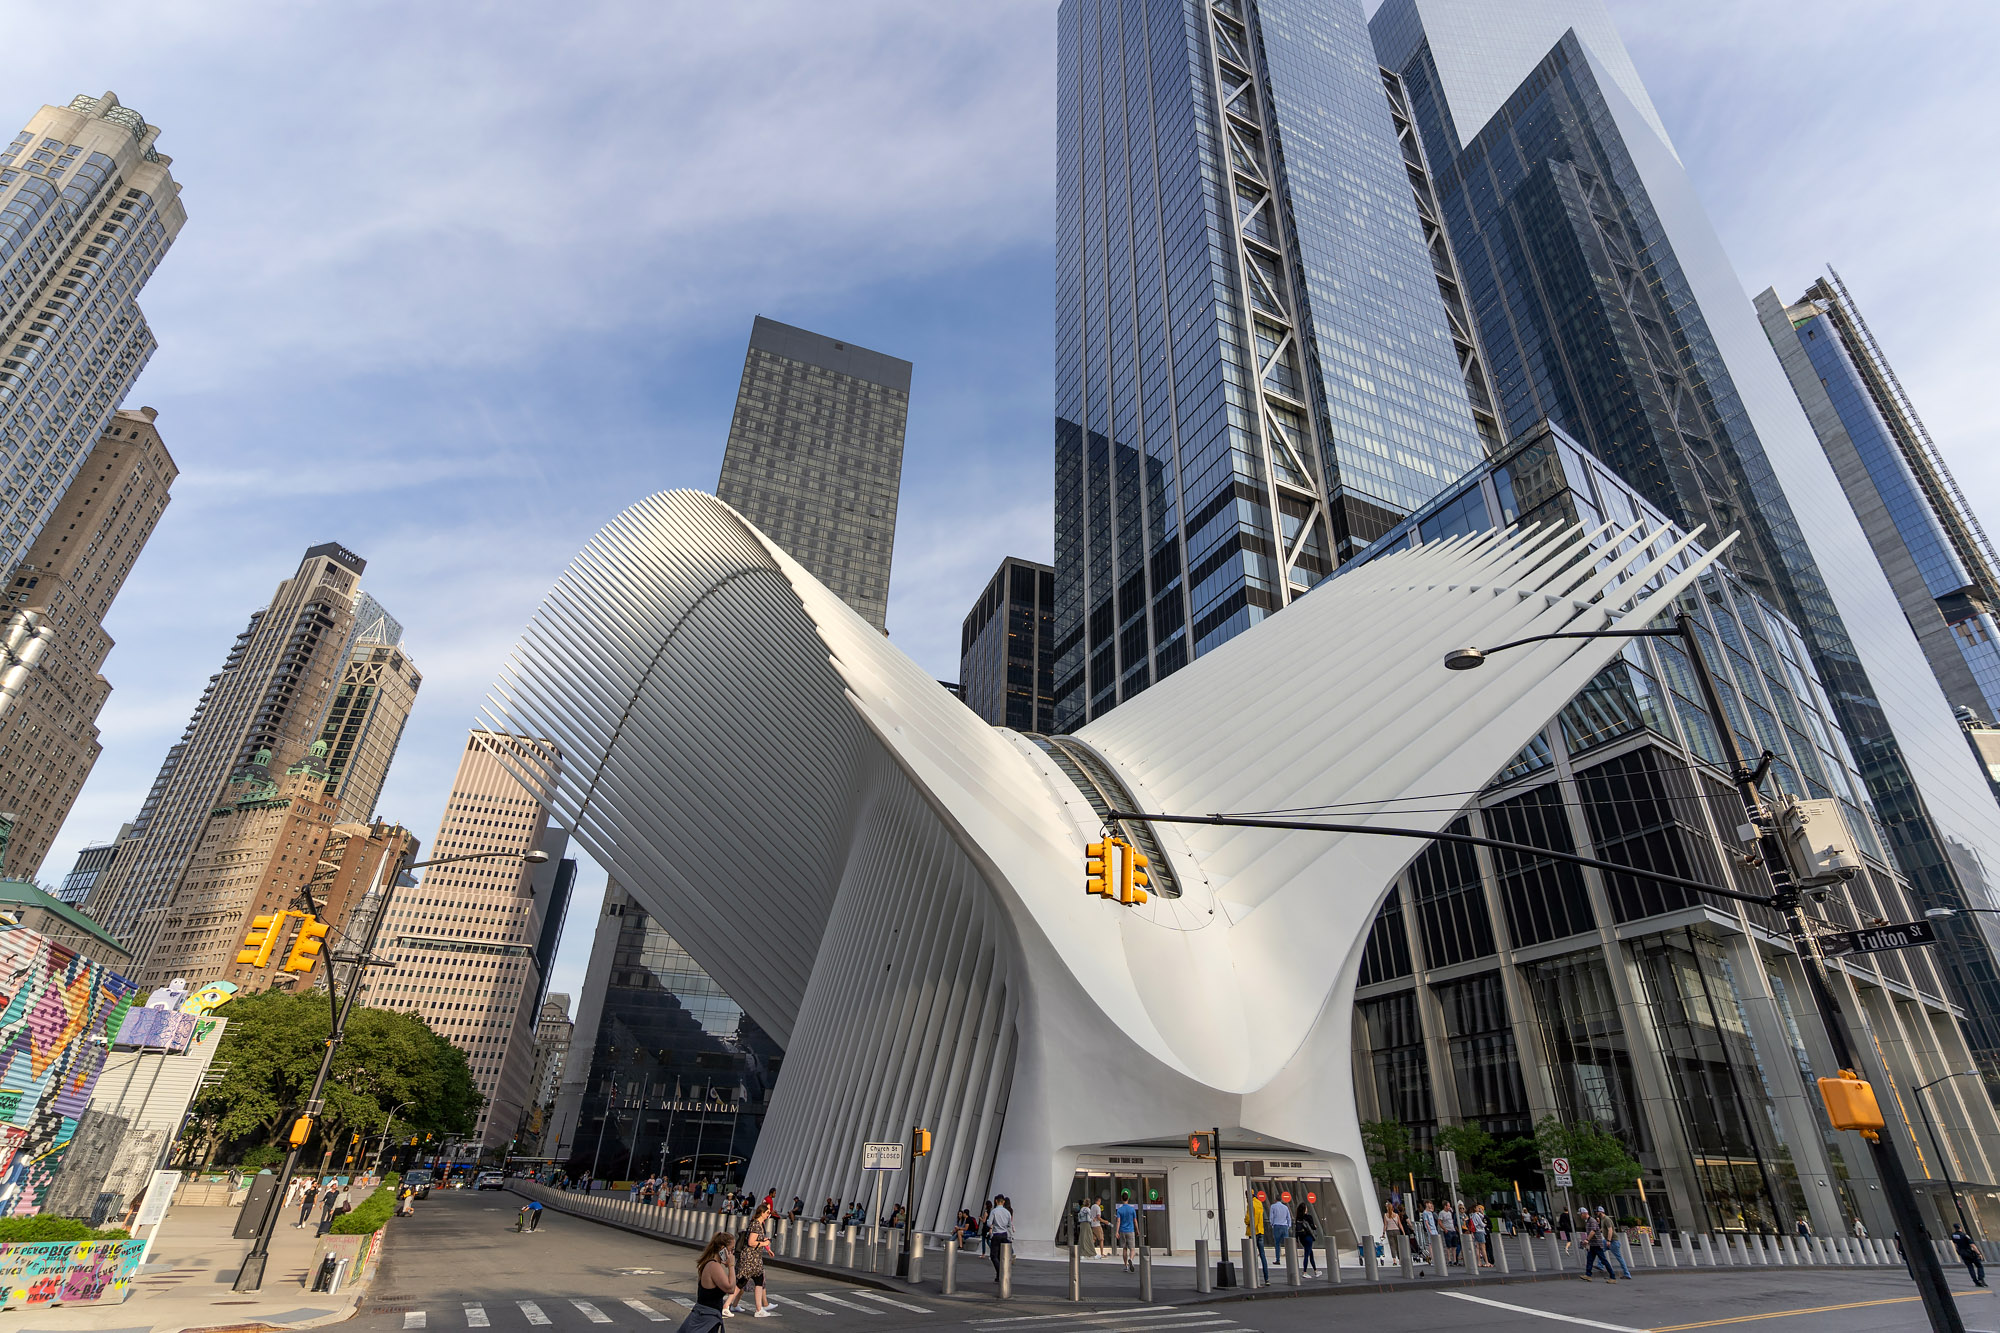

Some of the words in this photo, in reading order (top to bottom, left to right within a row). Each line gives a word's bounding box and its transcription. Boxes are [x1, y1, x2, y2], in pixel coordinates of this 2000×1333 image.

[1857, 930, 1909, 950] Fulton
[1909, 925, 1923, 937] St
[623, 1099, 650, 1109] THE
[661, 1101, 740, 1113] MILLENIUM
